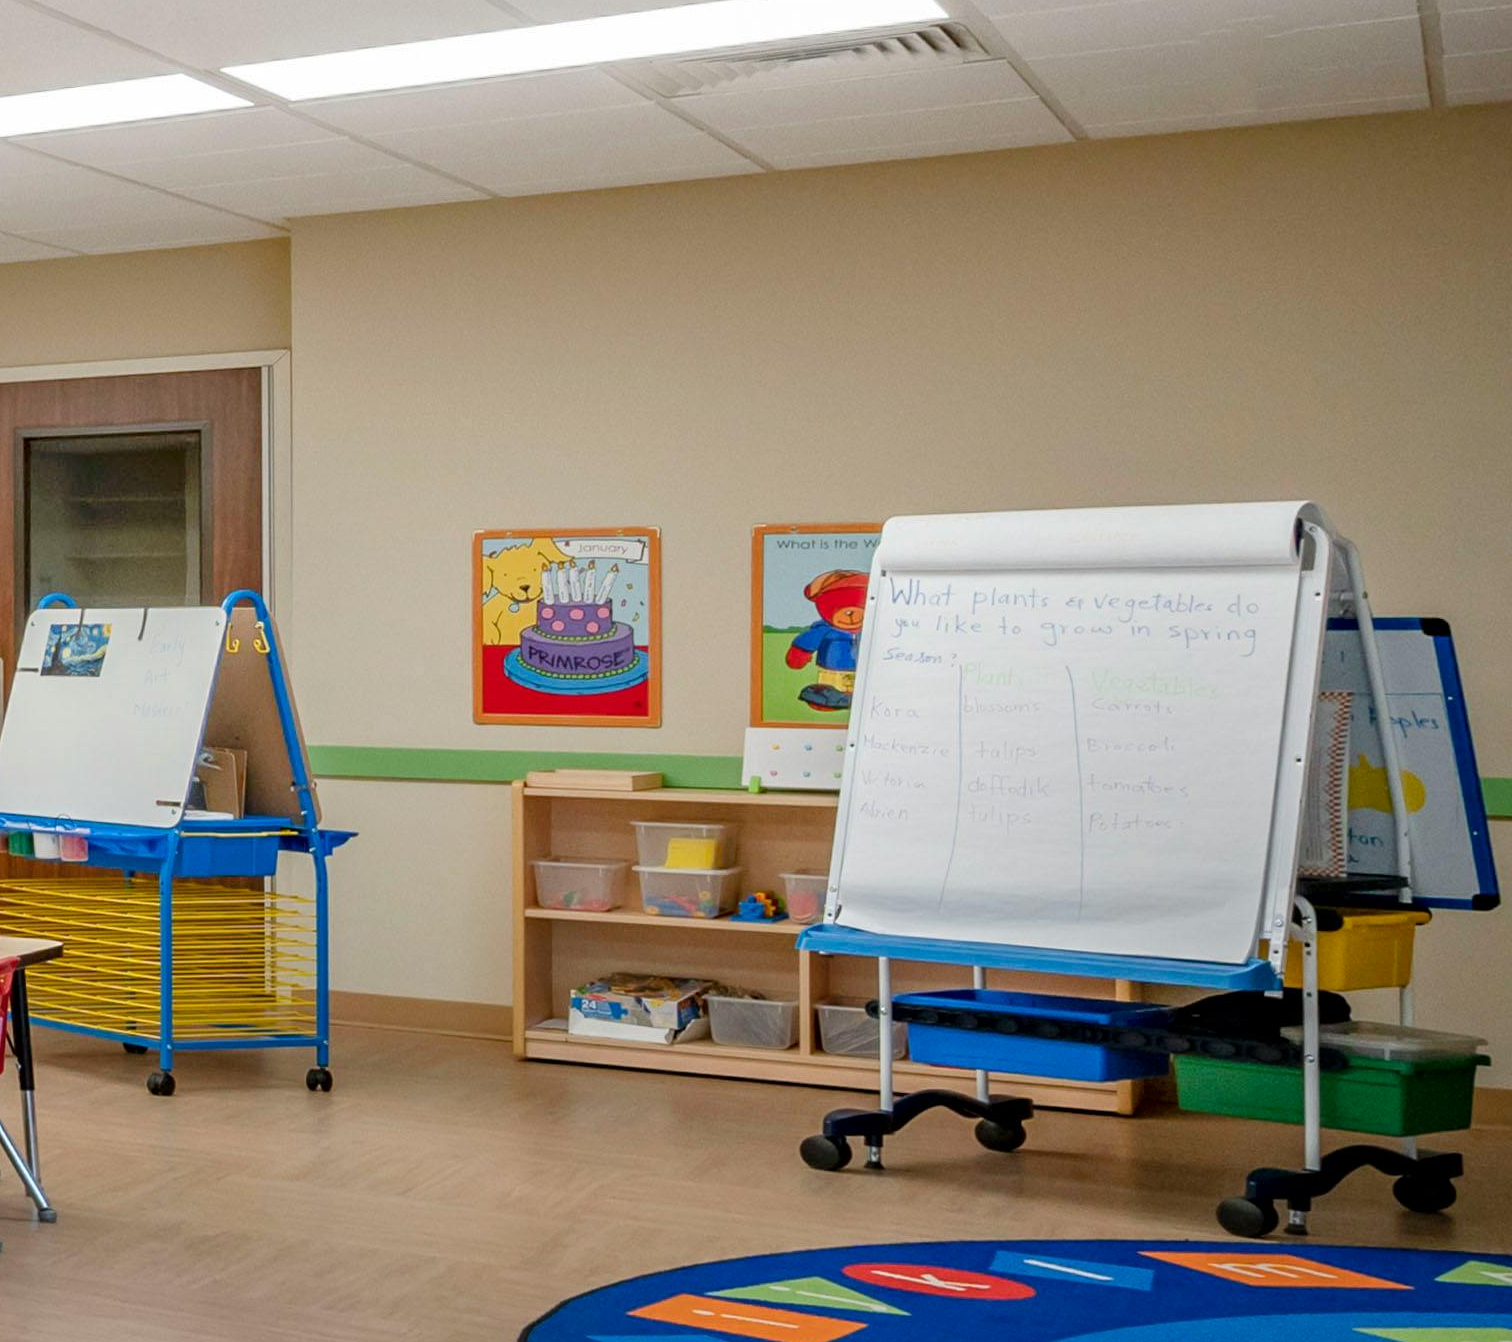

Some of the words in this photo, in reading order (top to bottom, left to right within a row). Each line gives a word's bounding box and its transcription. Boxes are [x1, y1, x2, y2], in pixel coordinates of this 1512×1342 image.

[578, 542, 629, 555] January
[776, 539, 815, 550] What
[820, 539, 830, 549] is
[831, 539, 858, 550] the
[890, 576, 954, 607] What
[972, 584, 1050, 622] plants
[1227, 593, 1260, 618] do
[891, 616, 920, 639] you
[936, 615, 982, 634] like
[999, 616, 1022, 635] to
[1040, 621, 1113, 647] grow
[1131, 623, 1151, 638] in
[1169, 623, 1258, 658] spring
[528, 645, 625, 671] PRIMROSE
[870, 695, 920, 720] Kora
[581, 999, 597, 1010] 24
